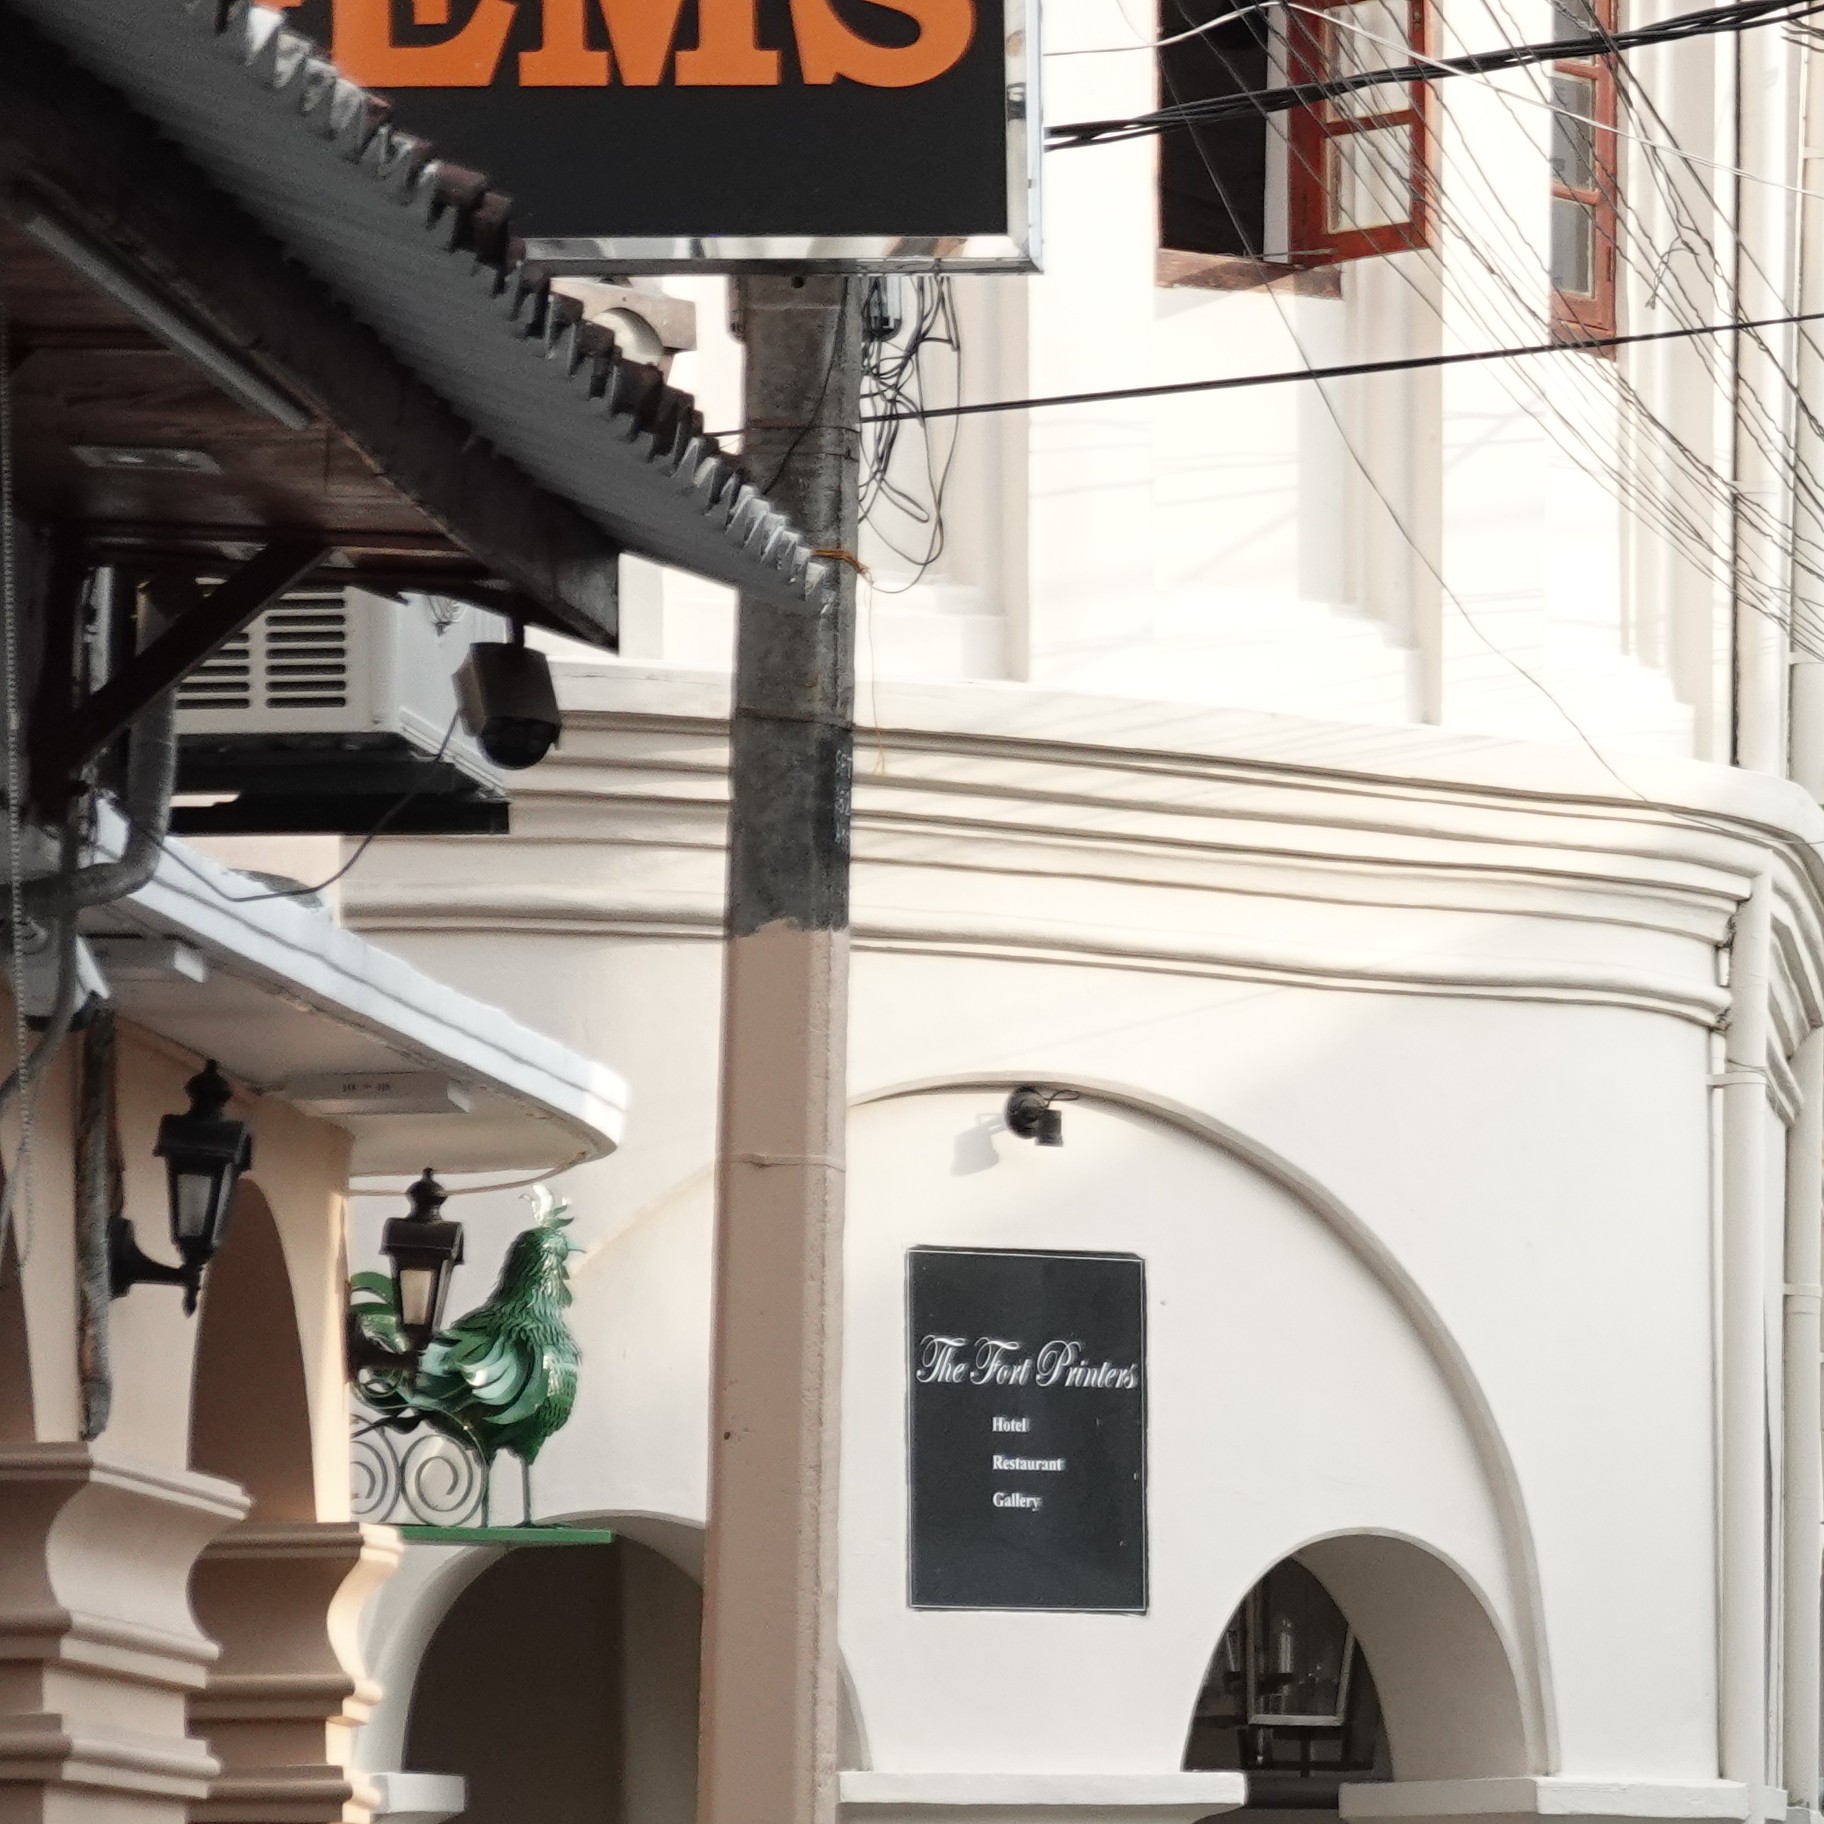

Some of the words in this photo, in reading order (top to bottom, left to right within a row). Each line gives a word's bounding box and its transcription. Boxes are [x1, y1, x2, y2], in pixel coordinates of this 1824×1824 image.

[916, 1334, 968, 1384] The
[970, 1336, 1033, 1385] Fort
[1035, 1339, 1139, 1389] Printers
[992, 1415, 1029, 1433] Hotel
[992, 1454, 1065, 1472] Restaurant
[992, 1491, 1043, 1511] Gallery
